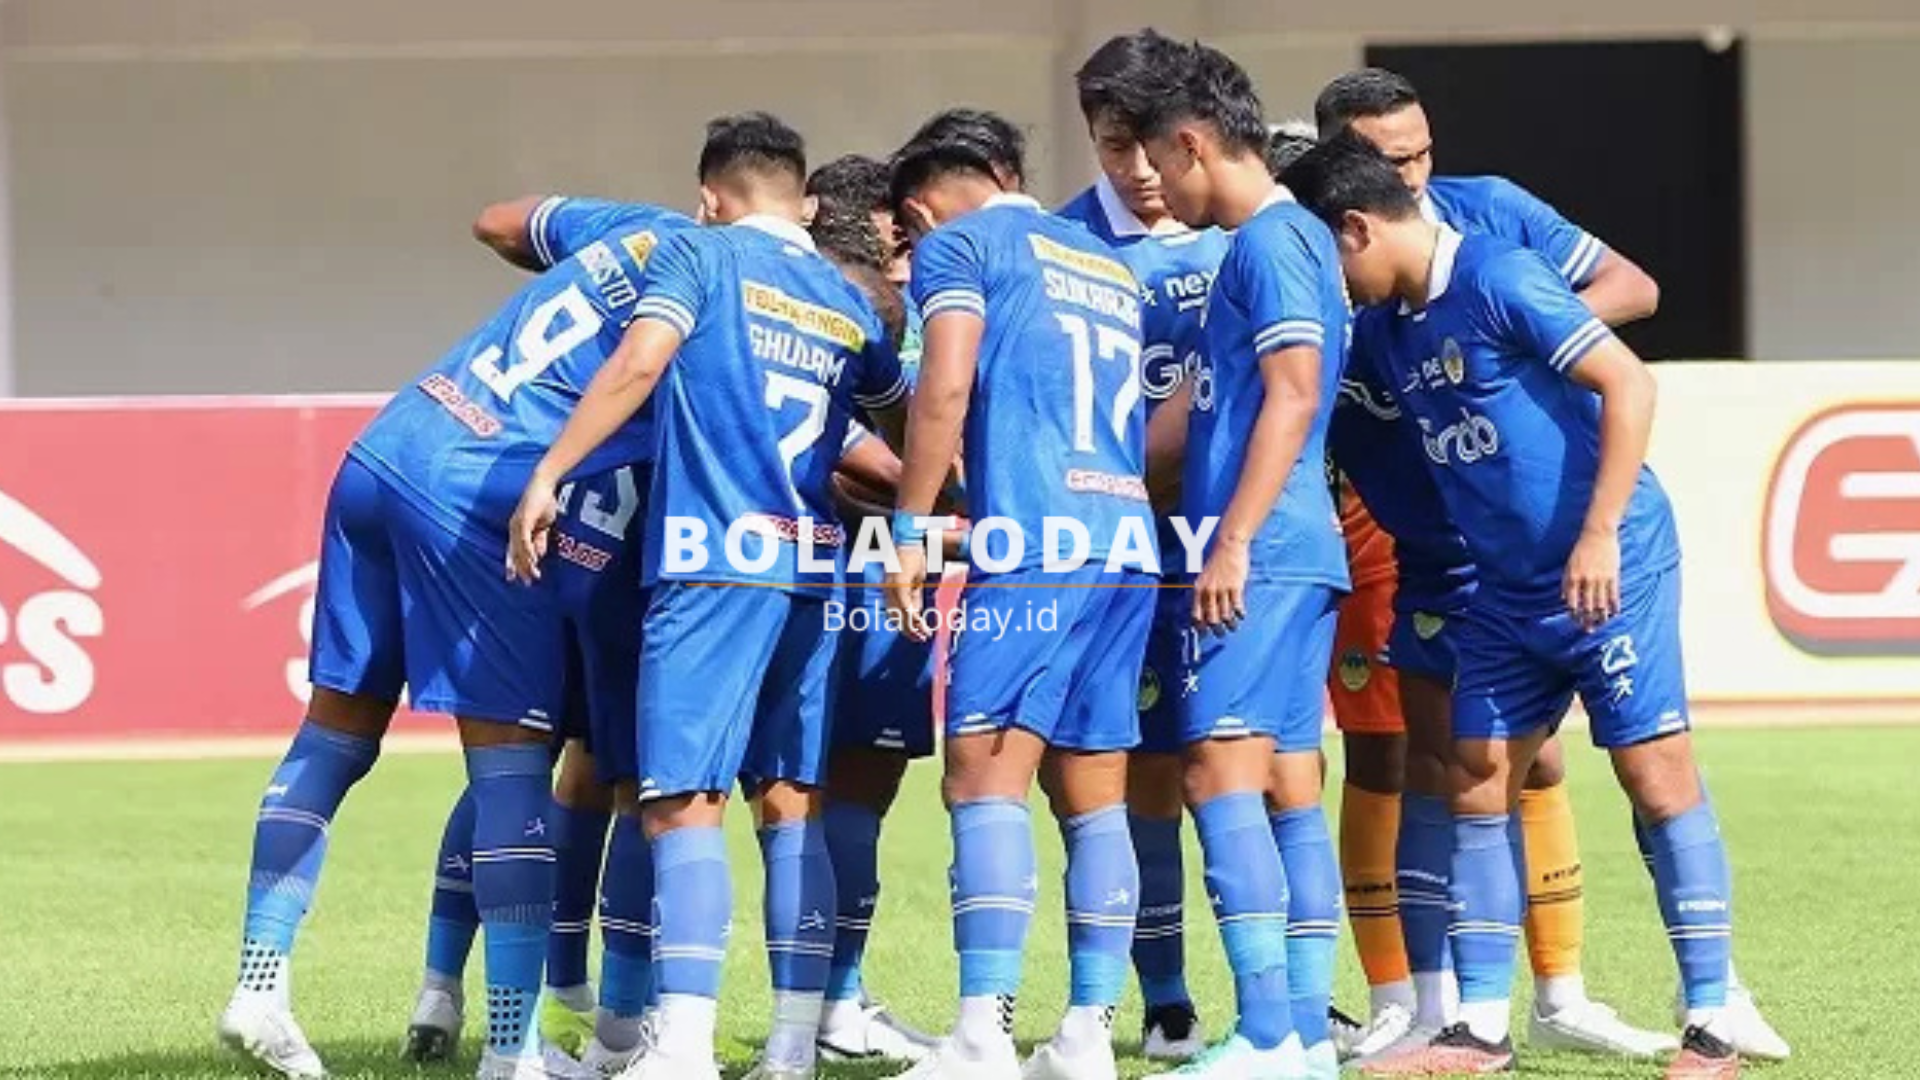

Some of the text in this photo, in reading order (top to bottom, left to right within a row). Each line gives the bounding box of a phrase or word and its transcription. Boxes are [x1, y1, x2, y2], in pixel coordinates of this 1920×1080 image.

[469, 282, 603, 405] 9
[750, 322, 846, 387] GHULAM
[1053, 312, 1143, 454] 17
[764, 371, 831, 515] 7
[1780, 422, 1920, 606] E
[1601, 634, 1638, 674] 23
